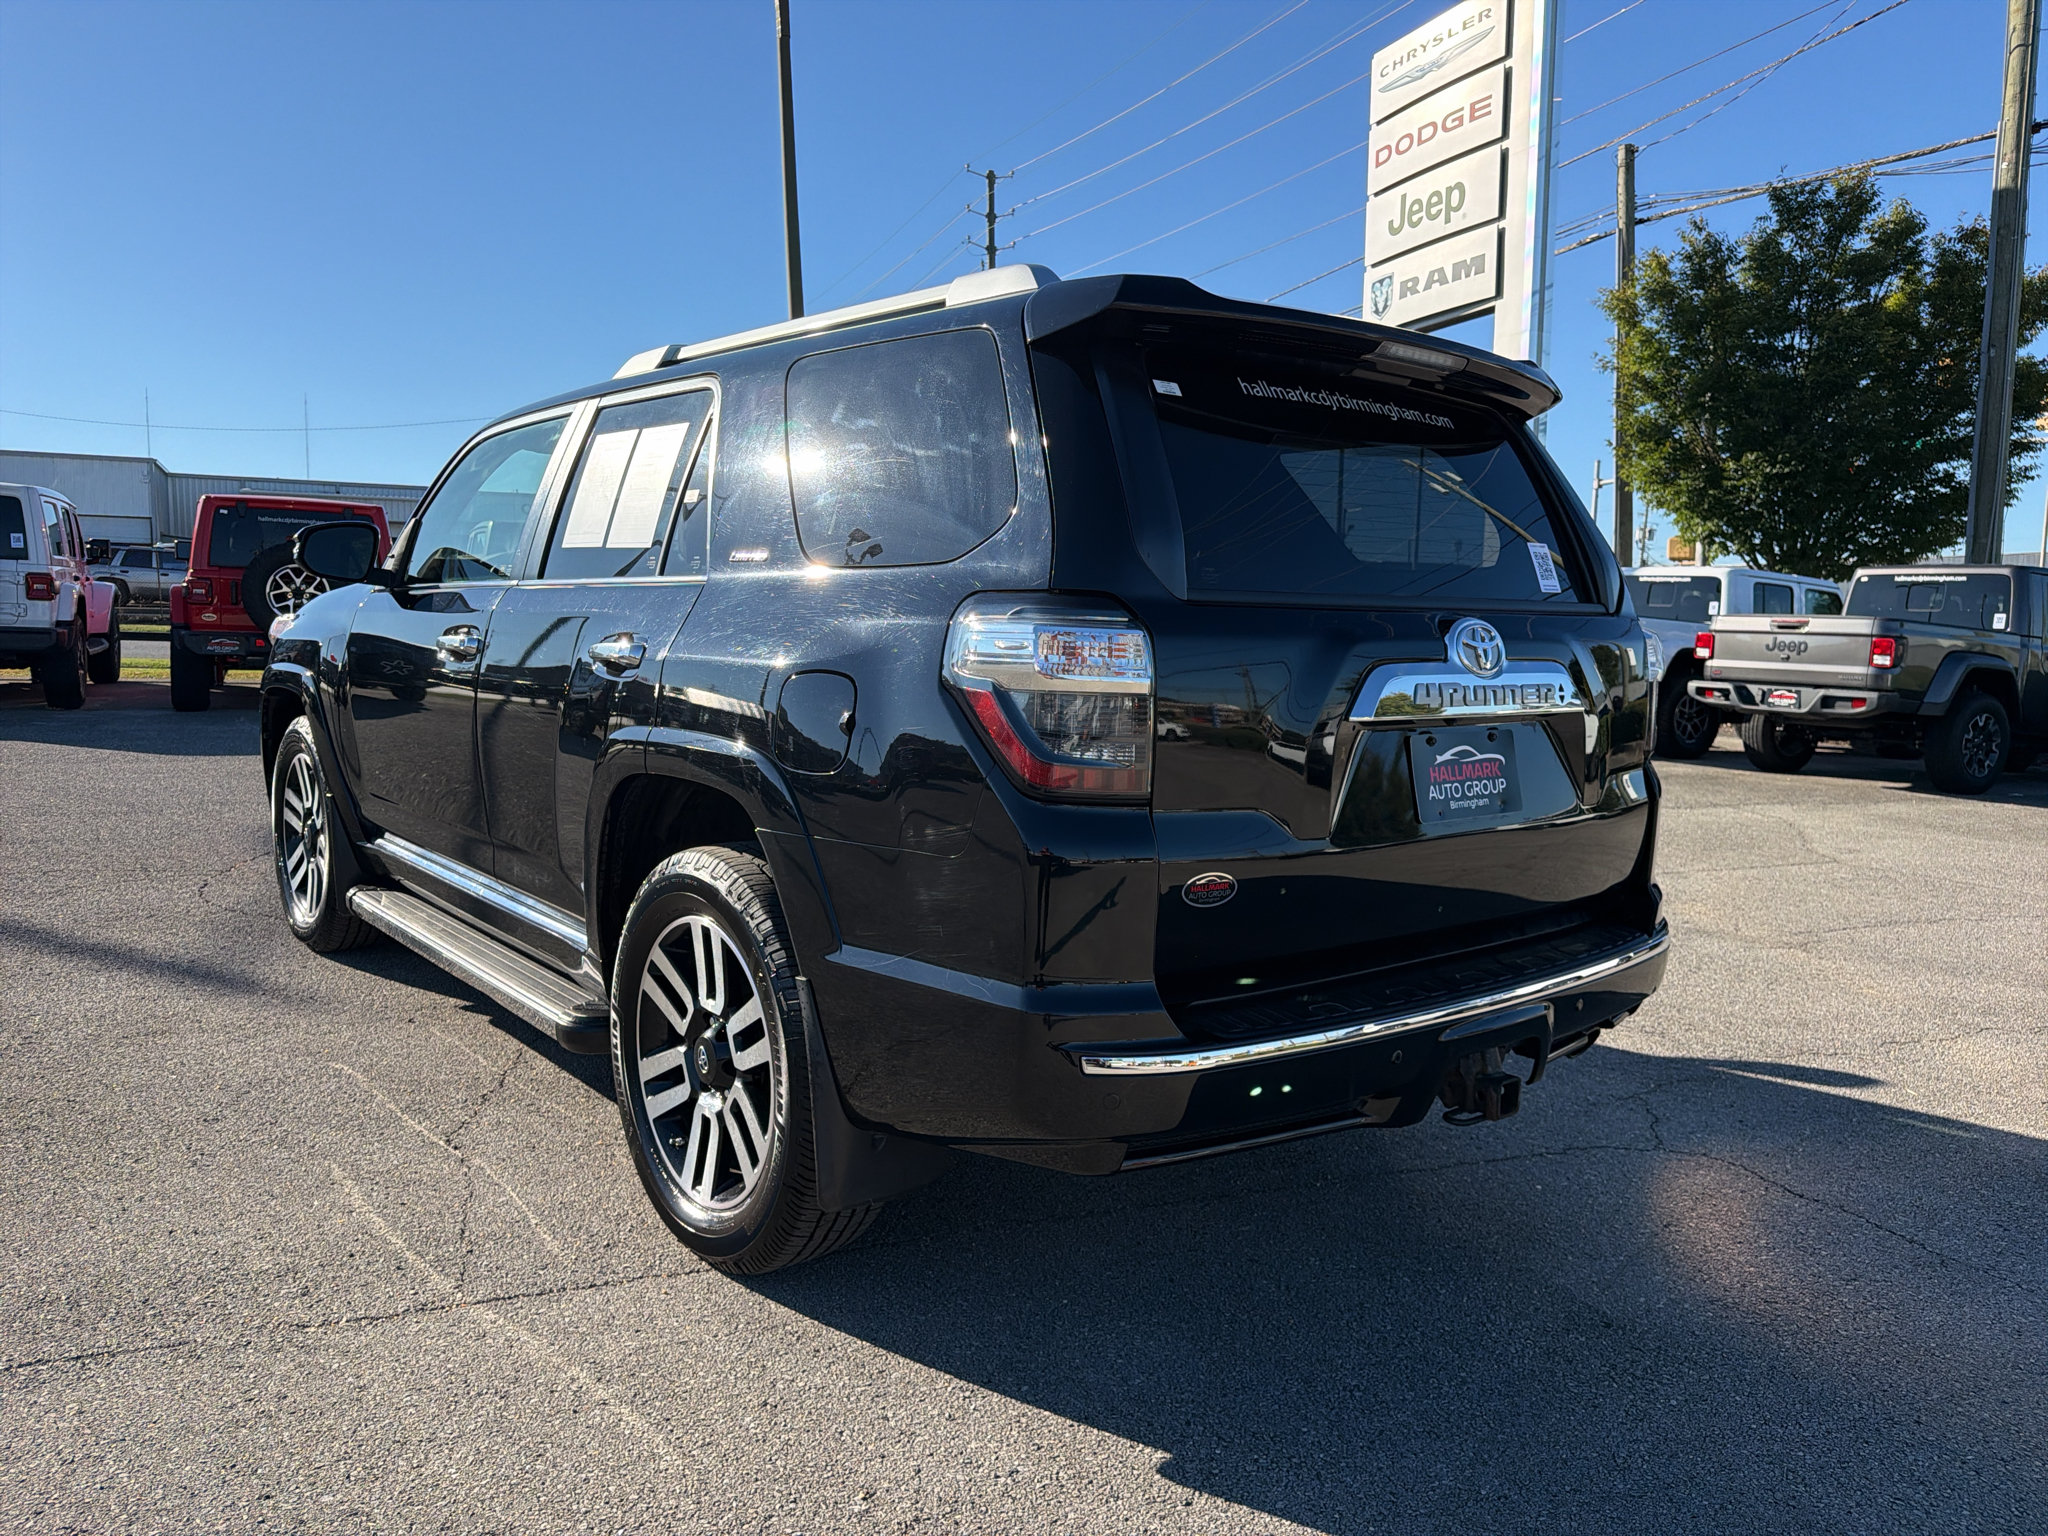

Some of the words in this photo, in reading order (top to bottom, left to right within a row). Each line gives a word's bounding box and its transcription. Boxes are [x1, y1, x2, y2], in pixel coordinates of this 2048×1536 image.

[1380, 7, 1493, 79] CHRYSLER
[1375, 94, 1493, 169] DODGE
[1388, 181, 1466, 237] Jeep
[1399, 253, 1487, 300] RAM
[1237, 377, 1455, 429] hallmarkcdjrbirmingham.com
[1765, 636, 1808, 656] Jeep
[1429, 760, 1502, 783] HALLMARK
[1429, 782, 1462, 800] AUTO
[1464, 778, 1507, 797] GROUP
[1450, 798, 1489, 809] Birmingham
[1189, 891, 1207, 900] AUTO
[1207, 889, 1232, 898] GROUP
[1190, 882, 1230, 893] HALLMARK
